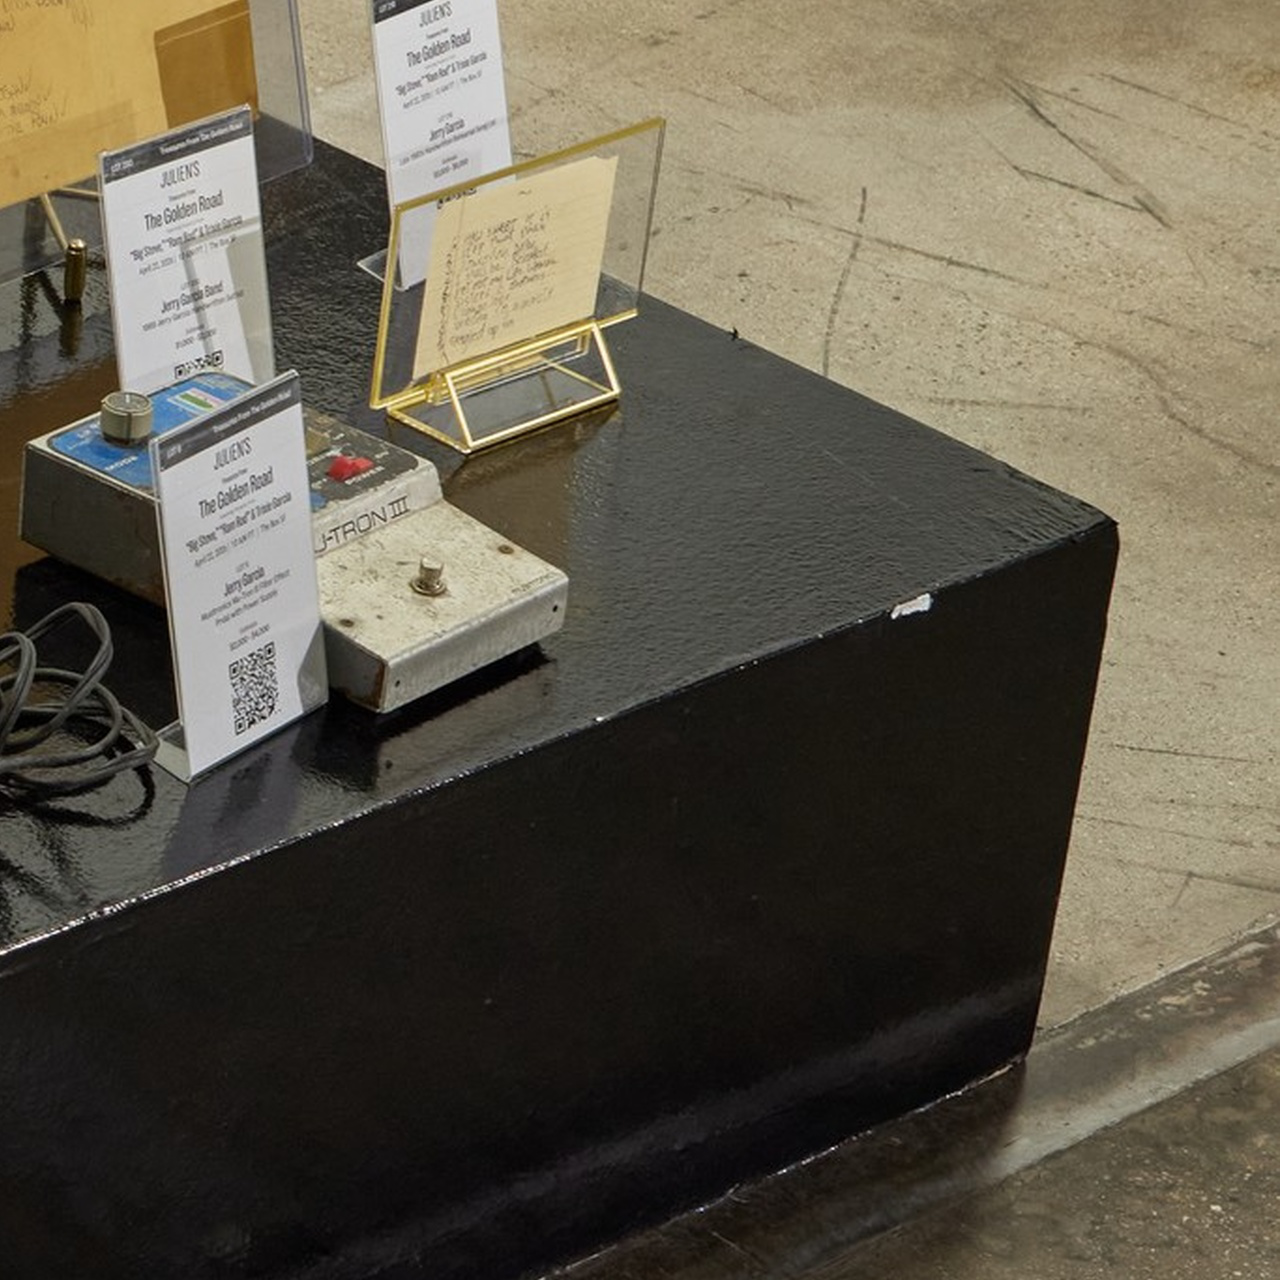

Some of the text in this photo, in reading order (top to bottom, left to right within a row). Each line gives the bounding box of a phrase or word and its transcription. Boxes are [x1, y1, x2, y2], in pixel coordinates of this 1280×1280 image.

[418, 0, 451, 27] JULIEN'S
[407, 27, 471, 68] The Golden Road
[159, 159, 200, 188] JULIEN'S
[144, 188, 223, 231] The Golden Road
[160, 280, 223, 315] Jerry Garcia Band
[104, 455, 138, 472] MODE
[212, 436, 250, 471] JULIEN'S
[198, 464, 273, 519] The Golden Road
[314, 506, 388, 553] U-TRON
[224, 564, 265, 597] Jerry Garcia
